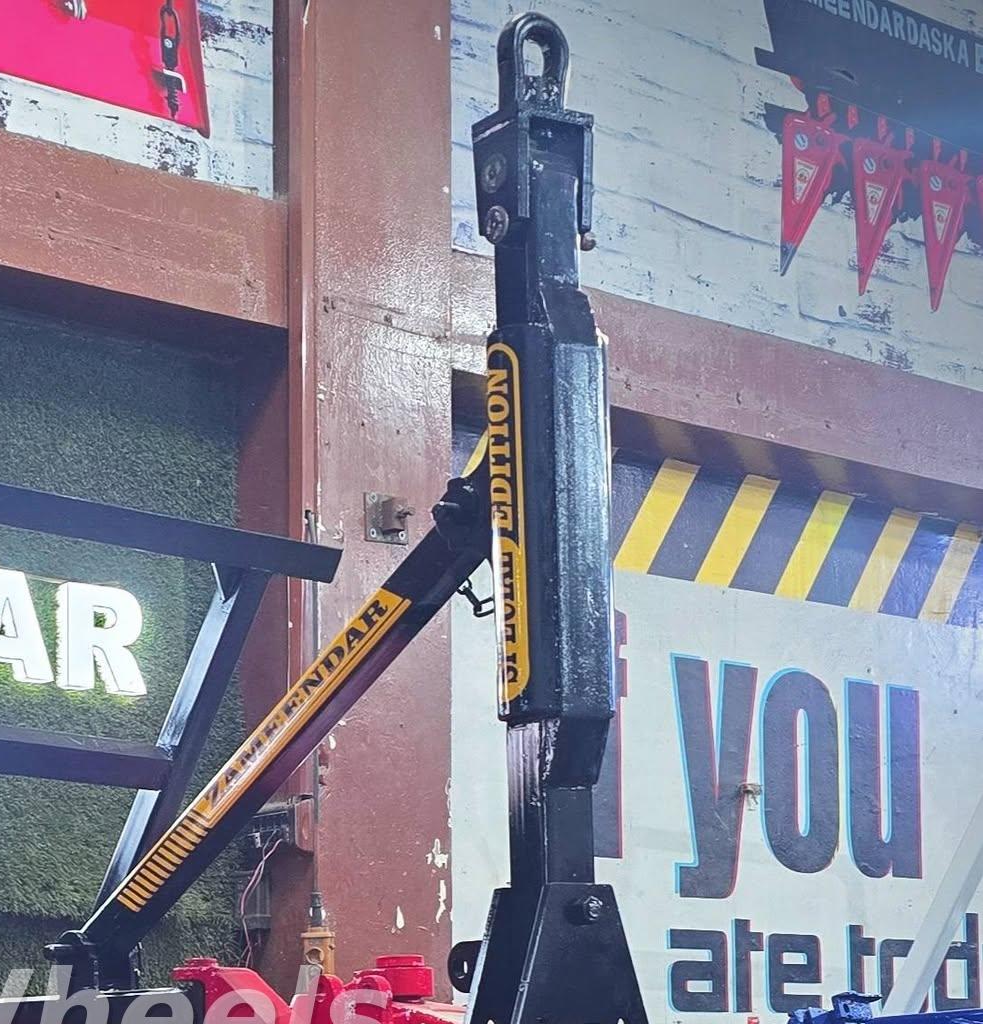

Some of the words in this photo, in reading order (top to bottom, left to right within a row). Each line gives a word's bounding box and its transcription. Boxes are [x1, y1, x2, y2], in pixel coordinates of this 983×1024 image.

[487, 368, 514, 532] EDITION
[670, 652, 923, 899] you
[666, 918, 823, 1014] ate
